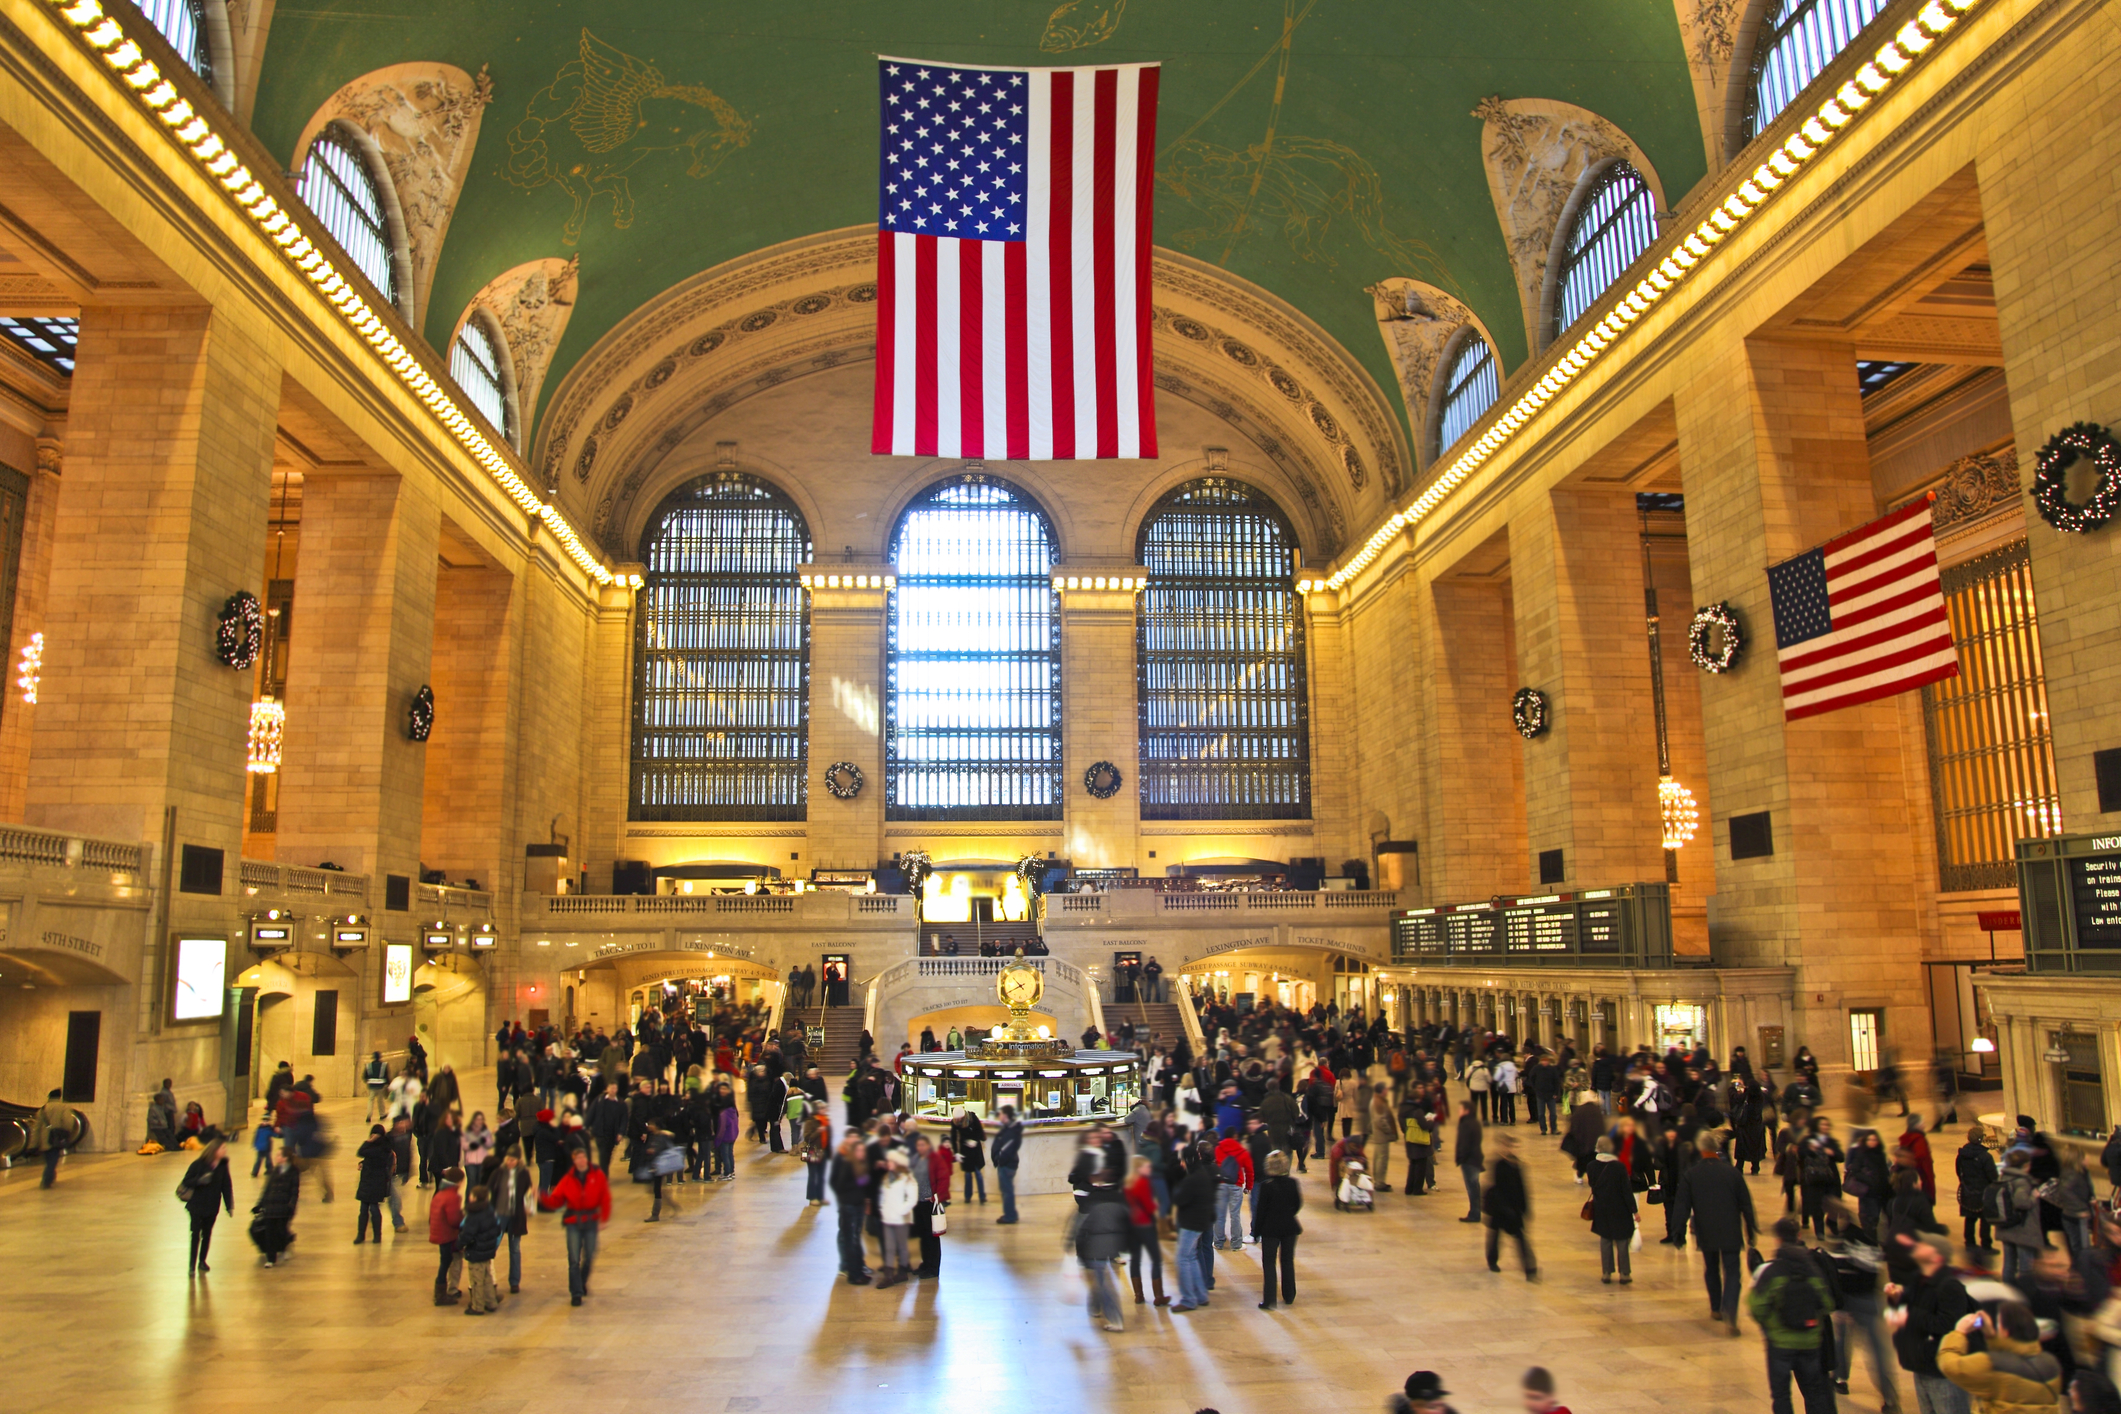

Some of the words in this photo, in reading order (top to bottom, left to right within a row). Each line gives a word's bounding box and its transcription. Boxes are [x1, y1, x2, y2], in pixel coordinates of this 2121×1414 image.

[2085, 861, 2117, 871] Security
[2086, 876, 2096, 885] on
[2095, 888, 2120, 898] Please
[2101, 902, 2118, 911] with
[2091, 916, 2104, 925] Law
[42, 931, 67, 947] 45TH
[67, 936, 102, 957] STREET
[1206, 939, 1253, 954] LEXINGTON
[1254, 937, 1270, 945] AVE
[1297, 936, 1324, 945] TICKET
[1327, 939, 1366, 953] MACHINES
[594, 945, 625, 957] TRACKS
[636, 942, 648, 950] TO
[685, 942, 733, 954] LEXINGTON
[735, 950, 751, 958] AVE
[642, 972, 660, 981] 42ND
[660, 968, 685, 977] STREET
[686, 966, 715, 974] PASSAGE
[720, 965, 749, 974] SUBWAY
[1182, 963, 1208, 973] STREET
[922, 1003, 943, 1012] TRACKS
[1009, 1042, 1046, 1050] Information
